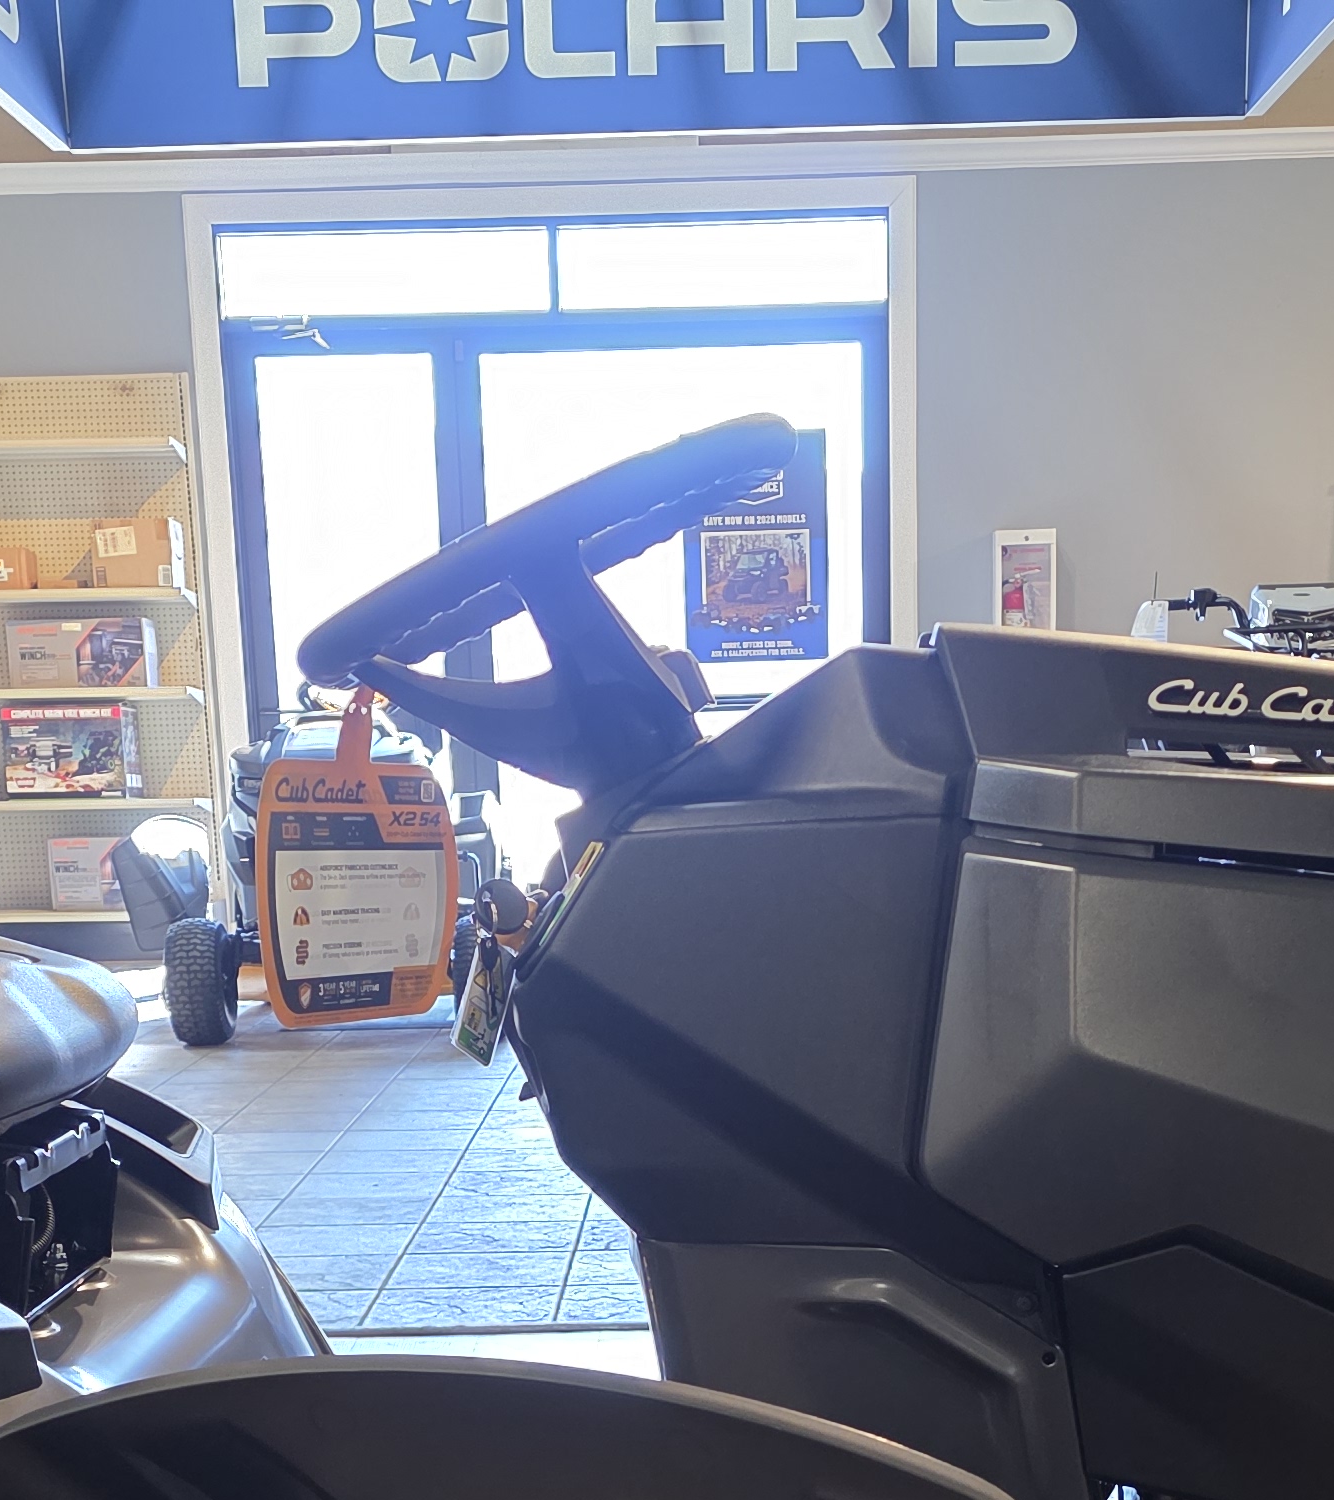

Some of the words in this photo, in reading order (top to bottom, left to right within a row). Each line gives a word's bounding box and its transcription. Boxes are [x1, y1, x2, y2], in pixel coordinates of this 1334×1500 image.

[233, 0, 1078, 88] POLARIS
[1147, 678, 1248, 717] Cub
[274, 776, 310, 804] Cub
